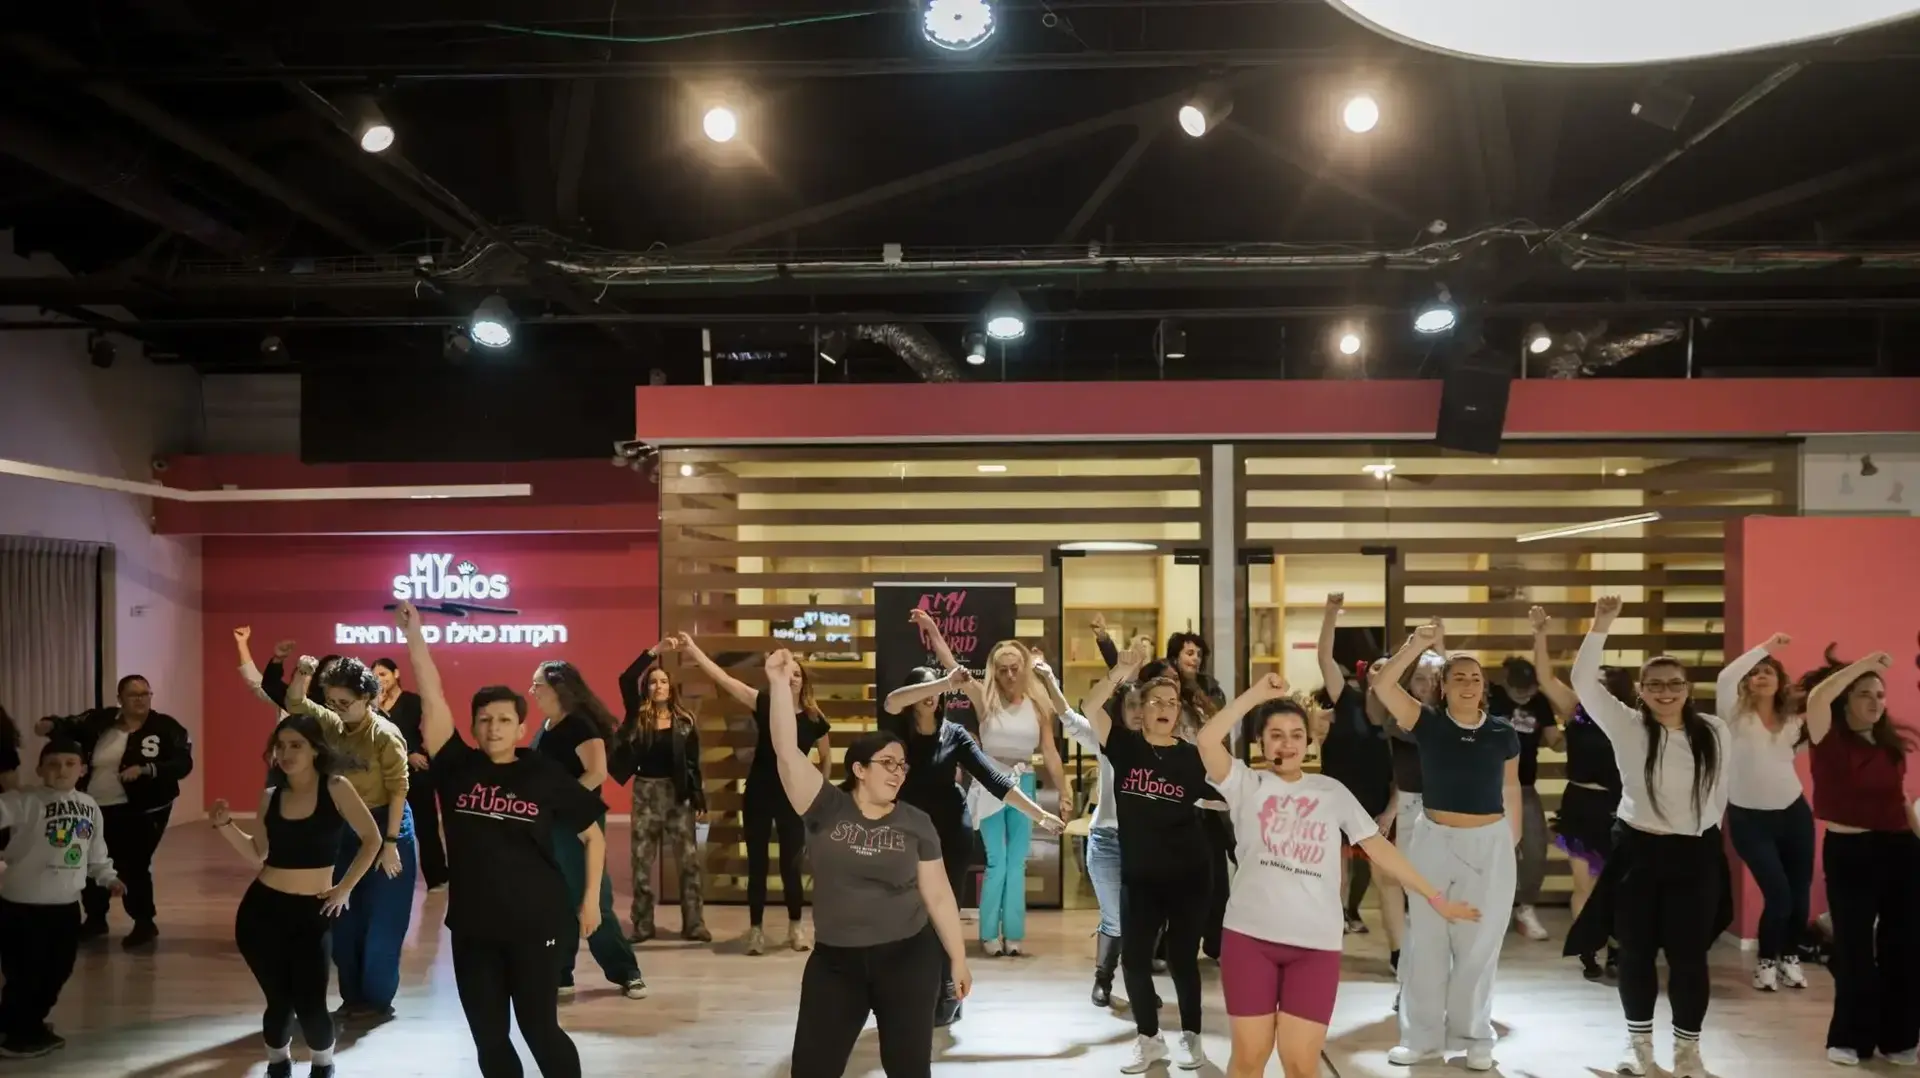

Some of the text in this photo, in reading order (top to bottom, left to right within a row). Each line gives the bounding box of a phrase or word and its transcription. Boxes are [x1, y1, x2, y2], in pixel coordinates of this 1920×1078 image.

[410, 553, 453, 577] MY
[392, 573, 509, 600] STUDIOS
[933, 590, 967, 616] MY
[141, 735, 160, 758] S
[1130, 768, 1154, 782] MY
[470, 782, 502, 798] MY
[1121, 777, 1185, 798] STUDIOS
[455, 793, 540, 816] STUDIOS
[830, 820, 906, 852] STYLE
